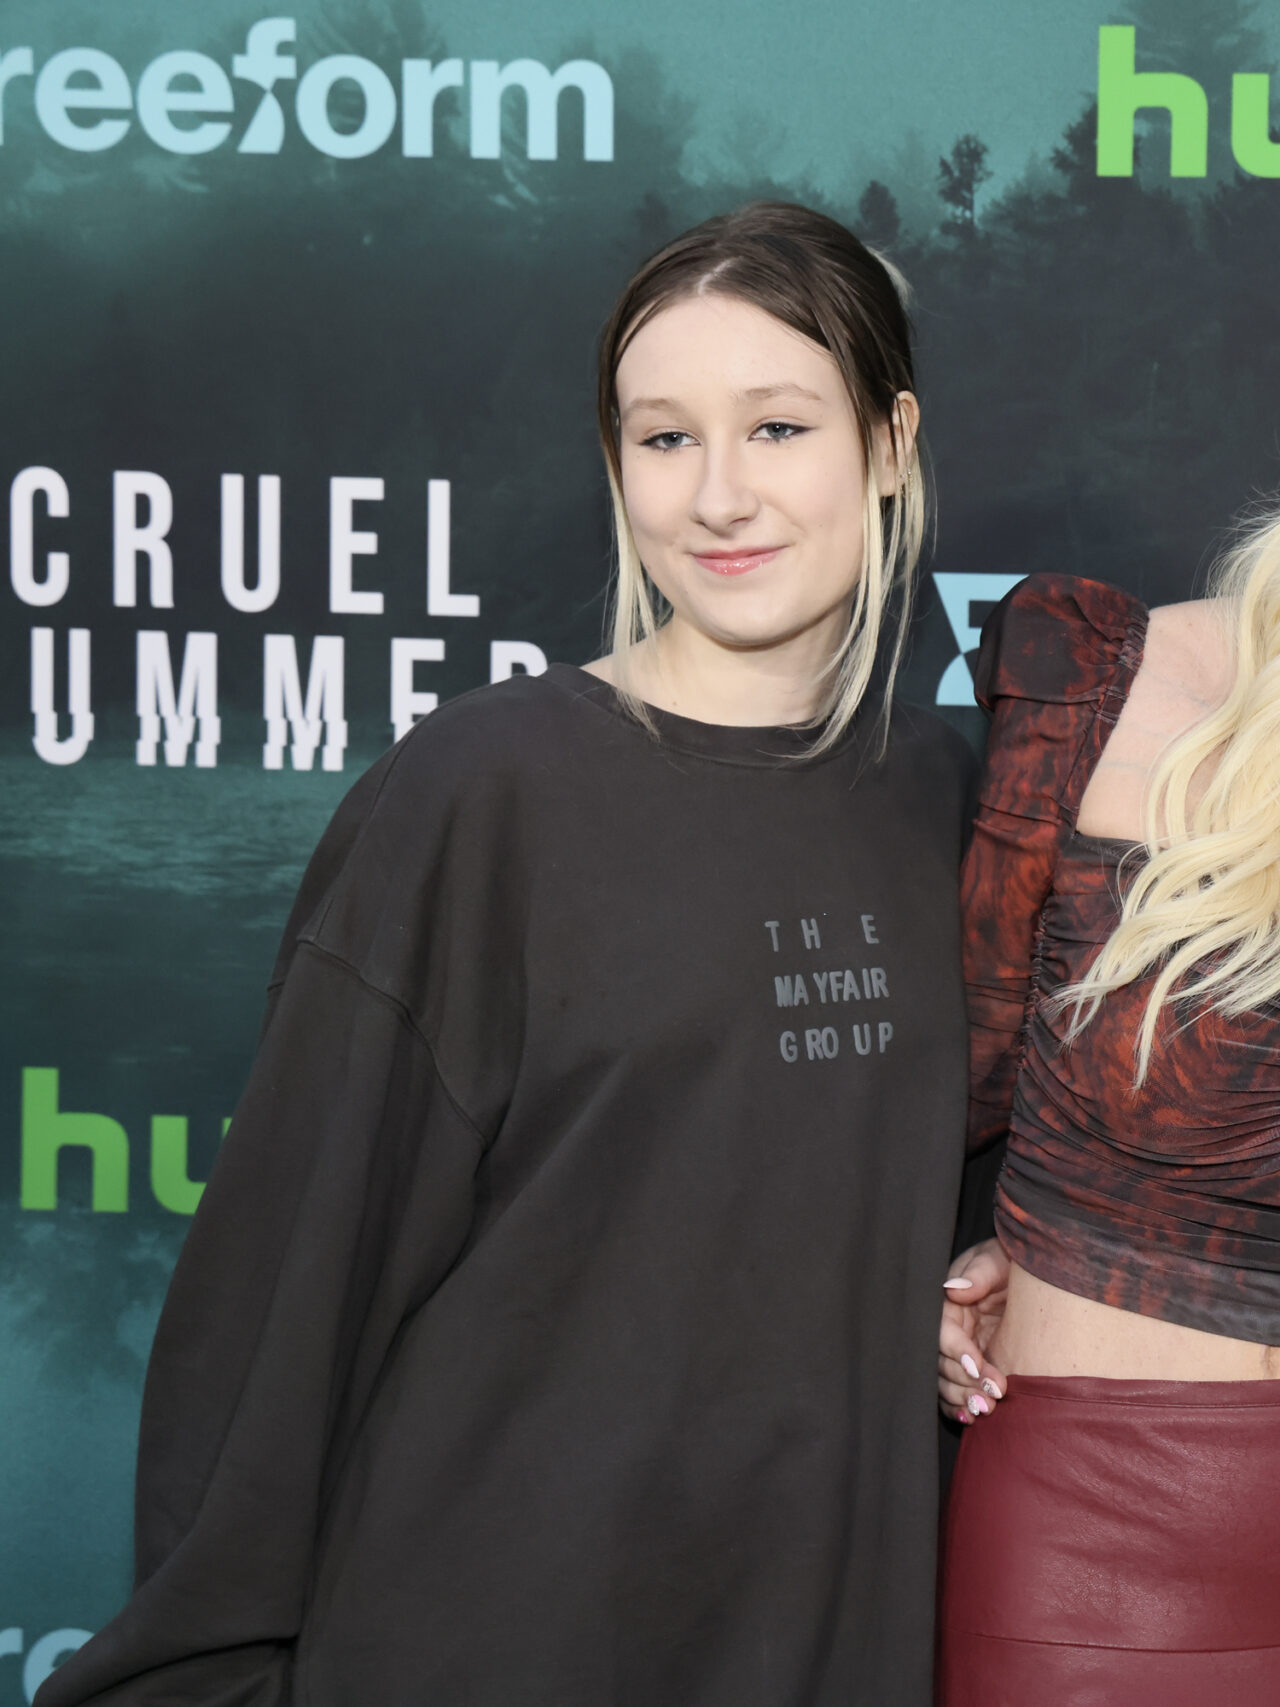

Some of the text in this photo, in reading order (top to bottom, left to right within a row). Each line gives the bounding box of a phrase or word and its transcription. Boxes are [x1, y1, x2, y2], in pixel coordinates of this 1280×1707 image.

[10, 466, 480, 617] CRUEL
[31, 627, 548, 772] UMME
[774, 967, 890, 1008] MAYFAIR
